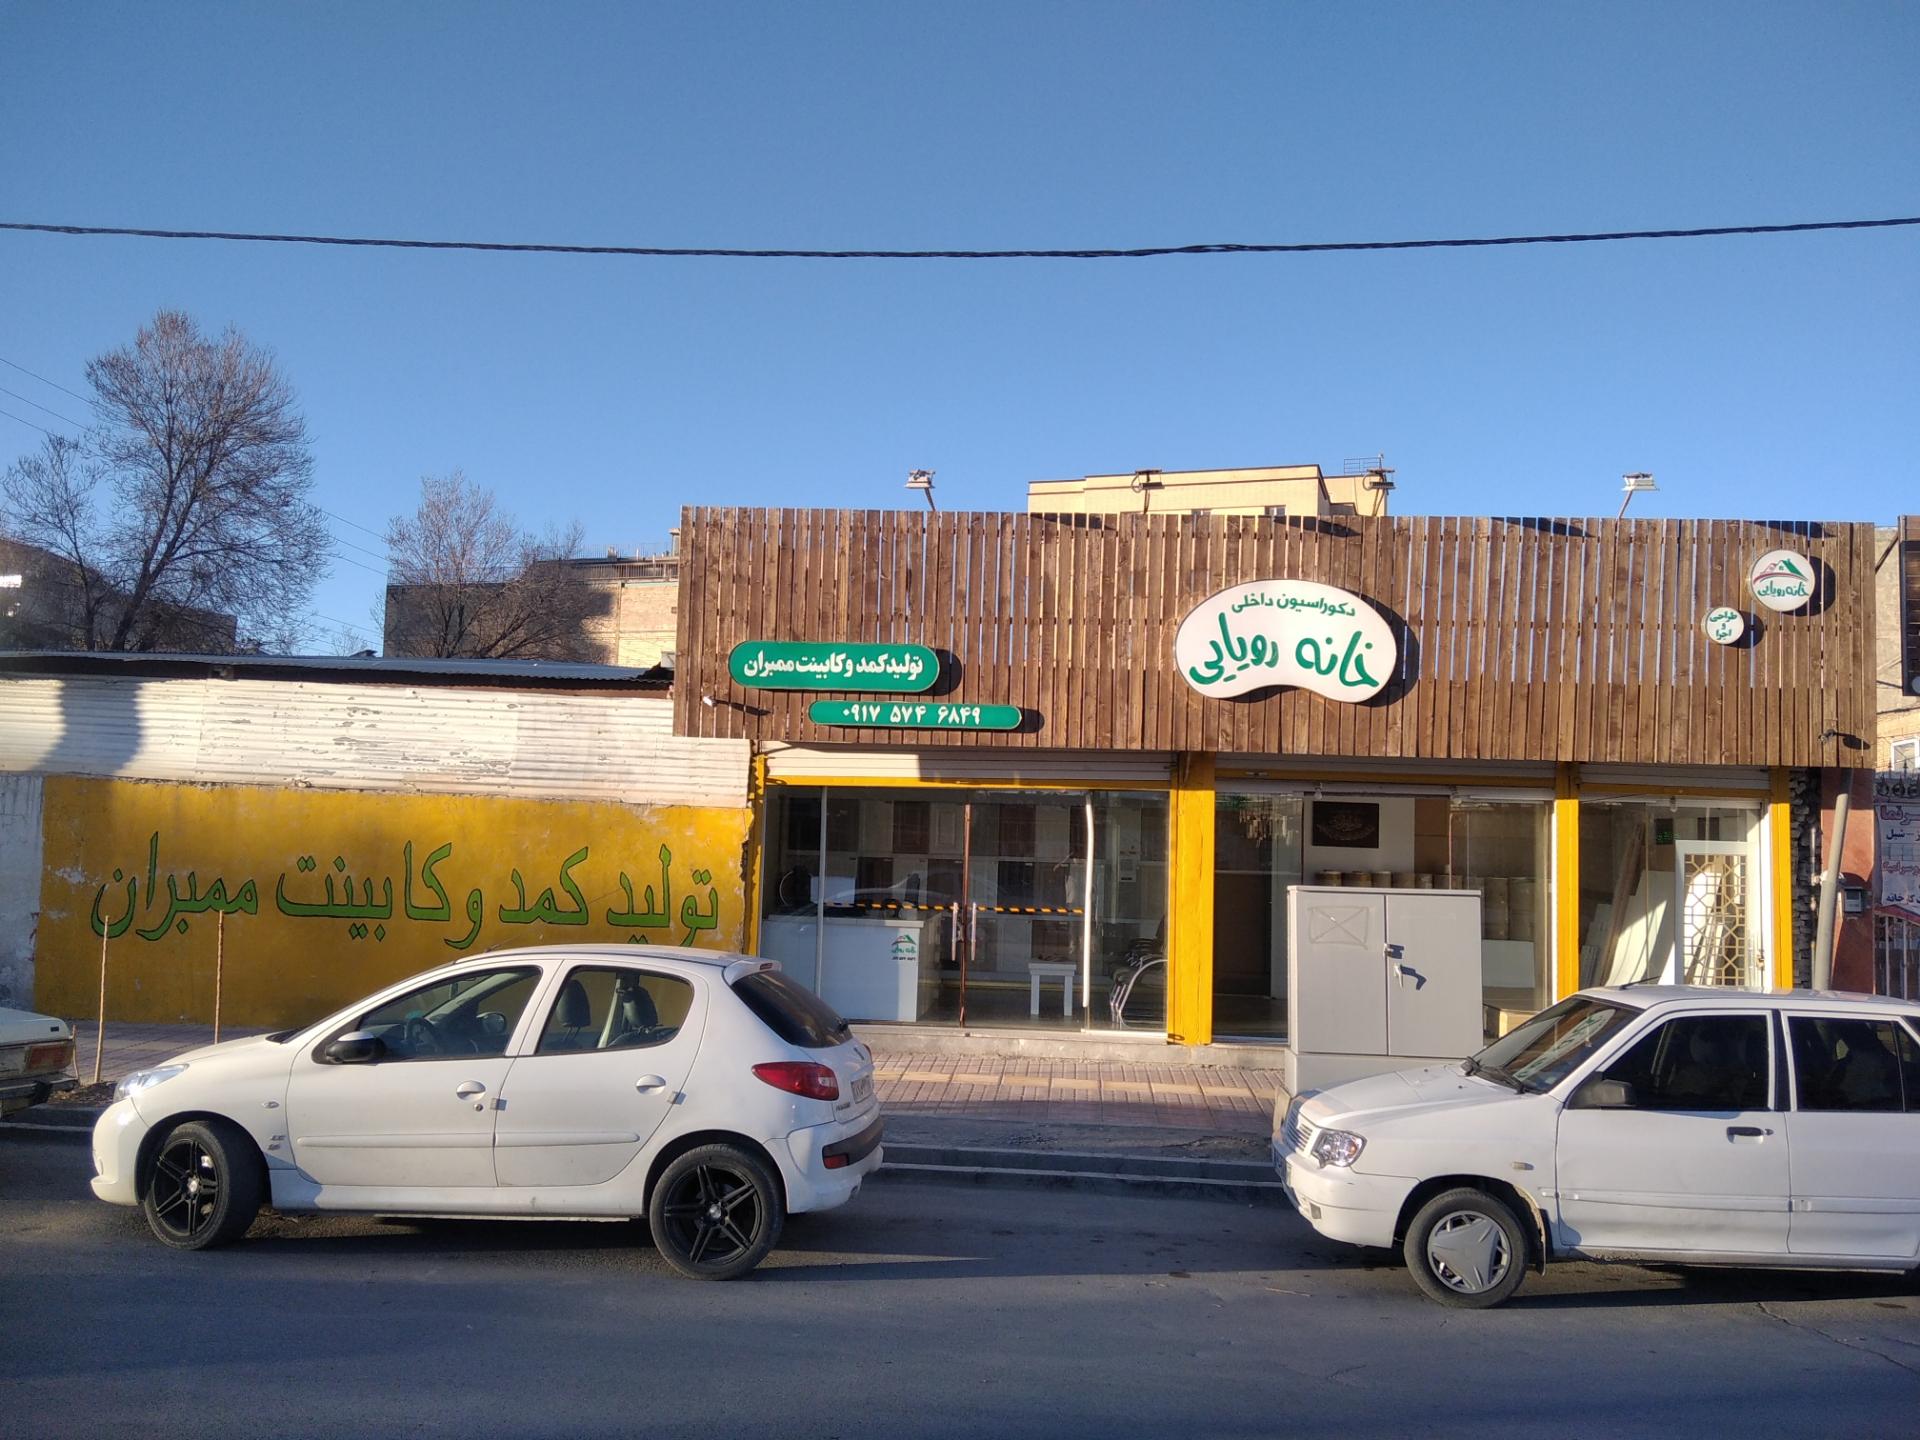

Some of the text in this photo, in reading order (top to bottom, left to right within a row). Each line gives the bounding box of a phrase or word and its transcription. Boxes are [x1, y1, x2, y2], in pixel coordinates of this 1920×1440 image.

[1757, 580, 1809, 597] خانه رویایی
[1231, 592, 1356, 617] دکوراسیون داخلی
[1709, 611, 1738, 623] طراحی
[1715, 628, 1732, 641] اجرا
[1188, 611, 1380, 688] خانه رویایی
[743, 649, 795, 678] ممبران
[795, 651, 847, 679] کابینت
[855, 653, 888, 674] کمد
[886, 652, 923, 681] تولید
[843, 703, 981, 726] ۰۹۱۷ ۵۷۴ ۶۸۴۹
[90, 830, 719, 950] تولید کمد و کابینت ممبران
